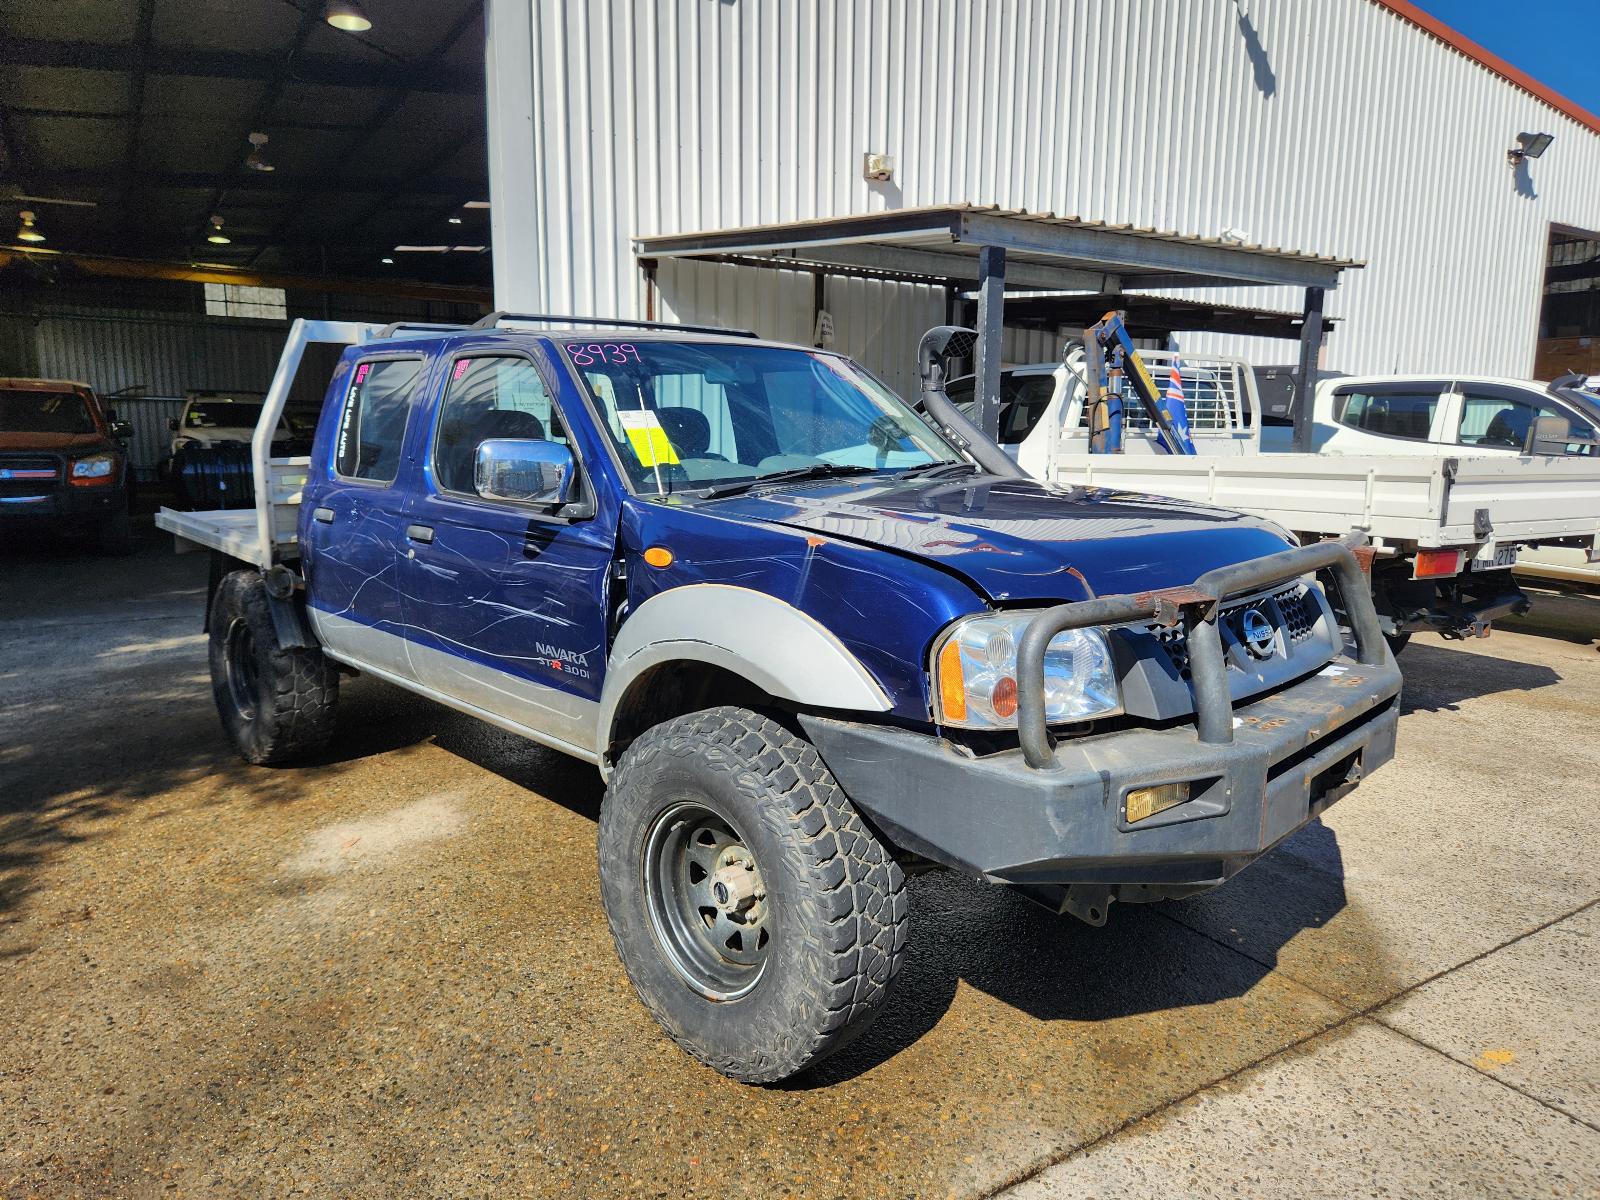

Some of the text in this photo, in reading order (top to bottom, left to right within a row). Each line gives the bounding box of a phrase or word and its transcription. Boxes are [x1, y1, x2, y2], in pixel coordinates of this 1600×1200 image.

[567, 343, 642, 365] 8939
[338, 430, 348, 458] AUTO
[1252, 628, 1272, 639] NISS
[535, 641, 589, 668] NAVARA
